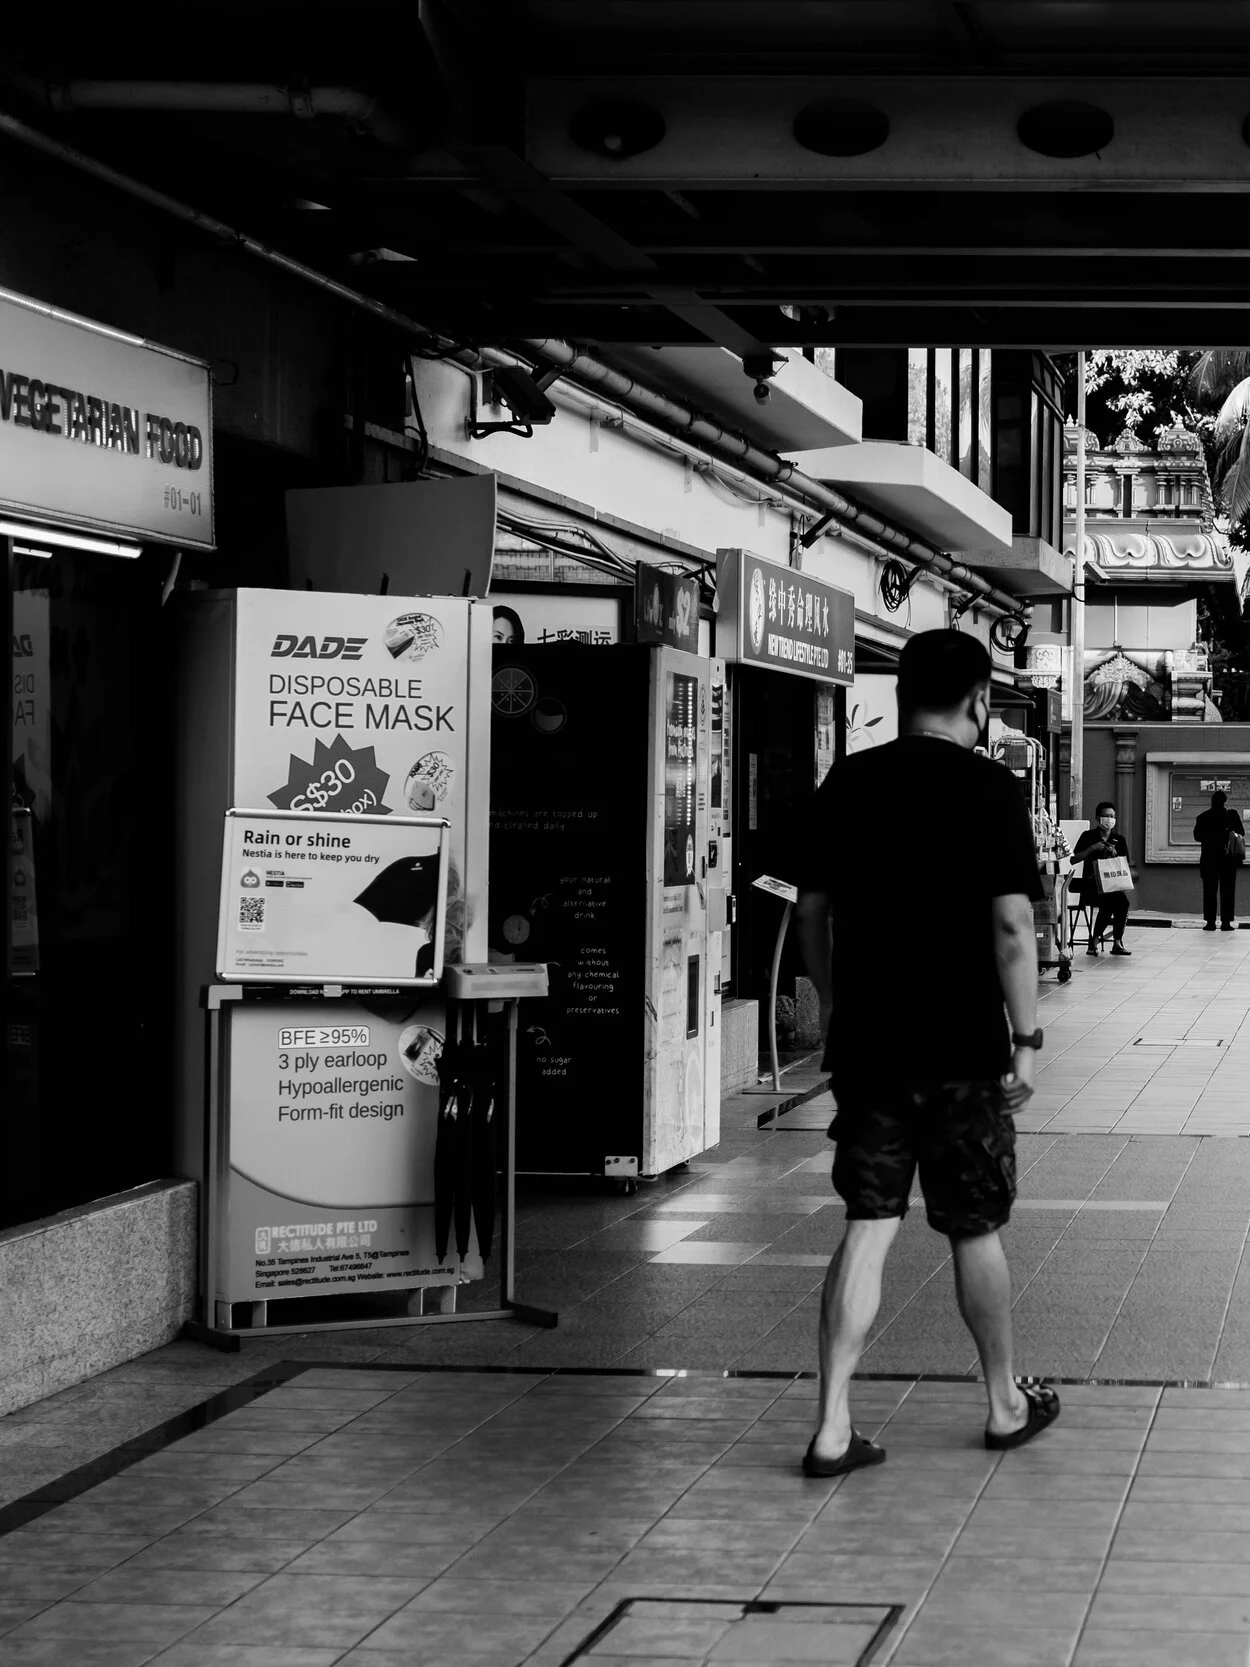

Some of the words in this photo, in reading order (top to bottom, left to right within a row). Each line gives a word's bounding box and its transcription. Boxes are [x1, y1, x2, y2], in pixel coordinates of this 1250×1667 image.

[0, 369, 139, 454] VEGETARIAN
[145, 413, 202, 470] FOOD
[164, 485, 201, 516] #01-01
[270, 634, 368, 660] DADE
[269, 674, 422, 699] DISPOSABLE
[270, 700, 354, 728] FACE
[366, 703, 455, 731] MASK
[244, 830, 280, 845] Rain
[285, 834, 302, 846] or
[307, 832, 351, 848] shine
[242, 849, 272, 858] Nestia
[275, 850, 282, 859] is
[285, 851, 306, 860] here
[308, 852, 318, 860] to
[320, 852, 342, 862] keep
[345, 855, 362, 864] you
[364, 854, 380, 864] dry
[580, 947, 606, 955] comes
[577, 959, 609, 967] without
[568, 971, 582, 980] any
[585, 970, 619, 979] chemical
[573, 982, 613, 993] flavouring
[566, 1007, 620, 1015] preservatives
[281, 1030, 316, 1046] BFE
[278, 1053, 289, 1070] 3
[295, 1052, 319, 1073] ply
[324, 1051, 387, 1070] earloop
[551, 1056, 572, 1066] sugar
[541, 1068, 567, 1076] added
[278, 1075, 404, 1099] Hypoallergenic
[278, 1103, 344, 1122] Form-fit
[349, 1101, 404, 1121] design
[271, 1223, 333, 1238] RECTITUDE
[336, 1221, 355, 1234] PTE
[358, 1220, 378, 1233] LTD
[277, 1257, 309, 1266] Tampines
[310, 1255, 340, 1263] Industrial
[341, 1253, 354, 1261] Ave
[255, 1269, 290, 1278] Singapore
[278, 1275, 356, 1286] sales@rectitude.com.sg
[357, 1272, 385, 1280] Website:
[386, 1267, 455, 1278] www.rectitude.com.sg
